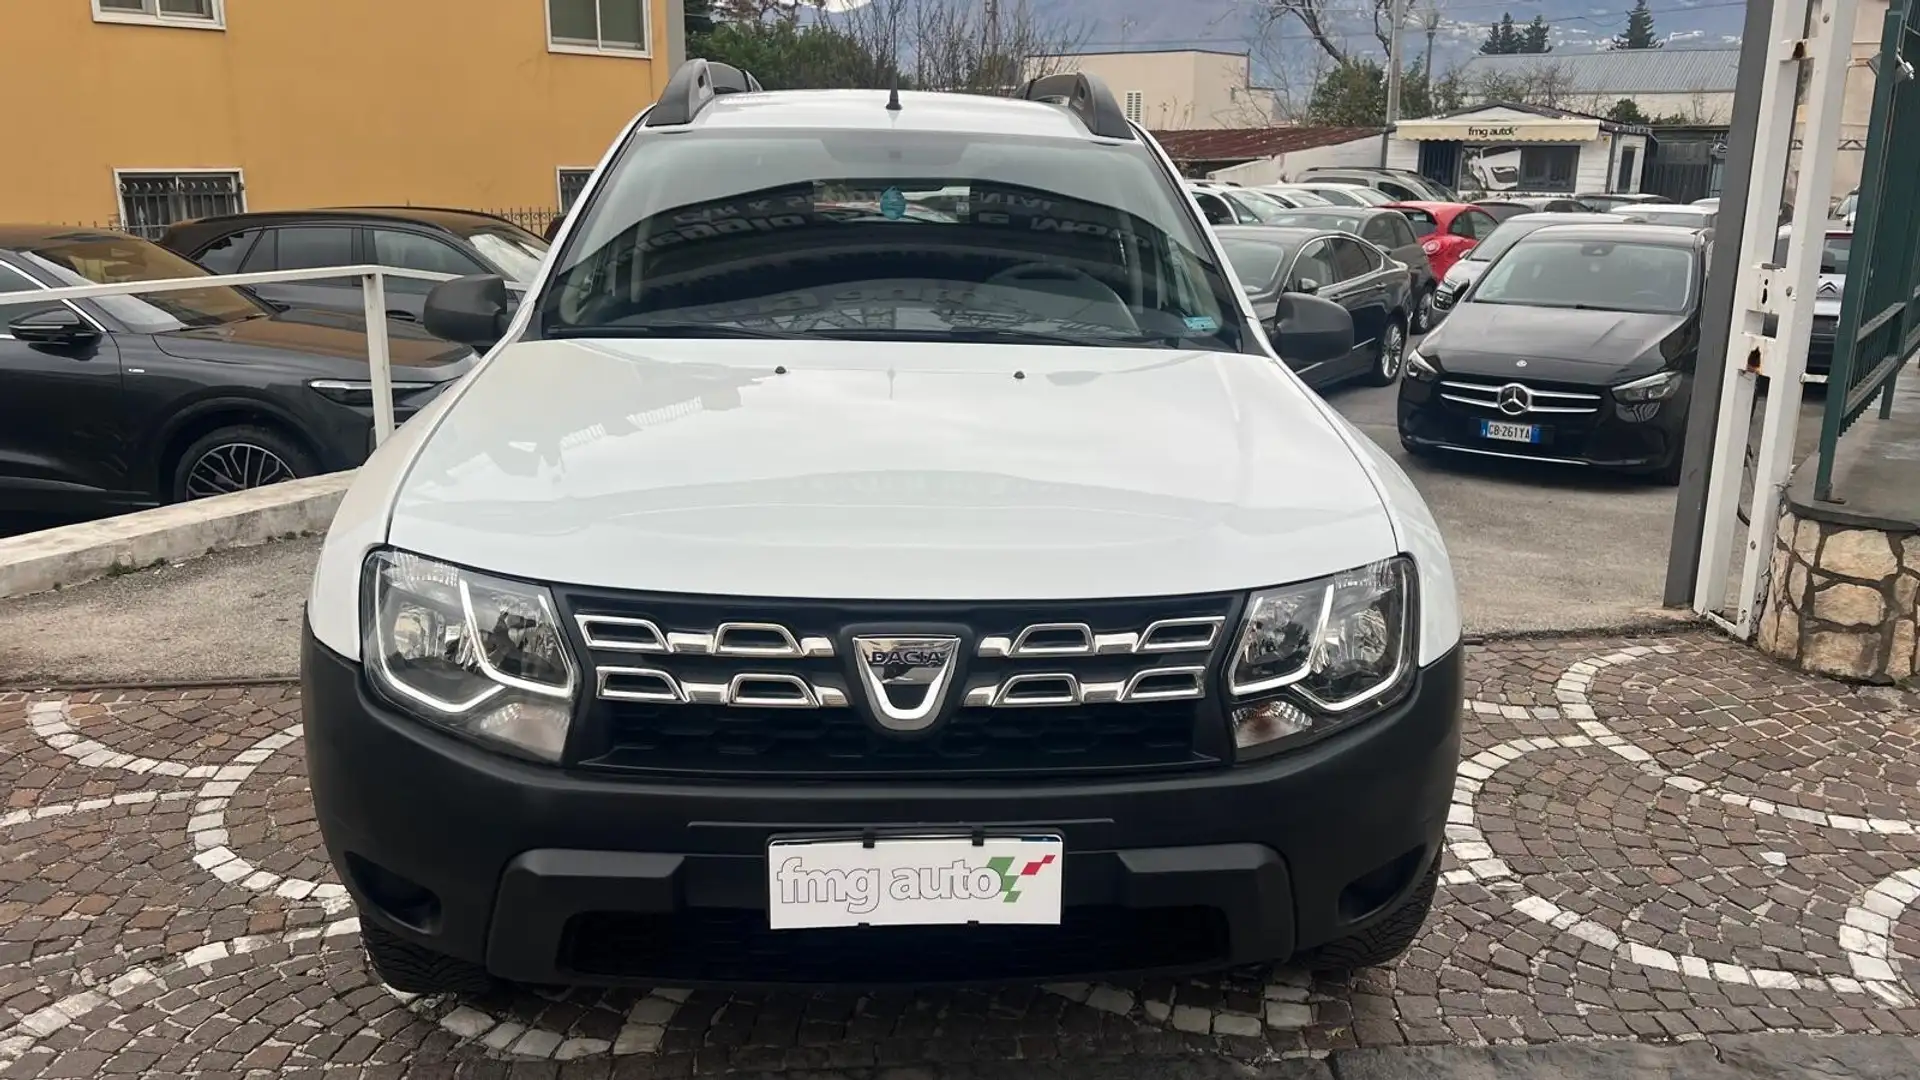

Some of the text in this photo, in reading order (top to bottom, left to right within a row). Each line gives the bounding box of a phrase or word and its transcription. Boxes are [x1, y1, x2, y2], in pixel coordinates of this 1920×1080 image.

[1468, 126, 1488, 138] fmg
[871, 651, 941, 665] DACIA
[777, 857, 1002, 914] fmg auto
